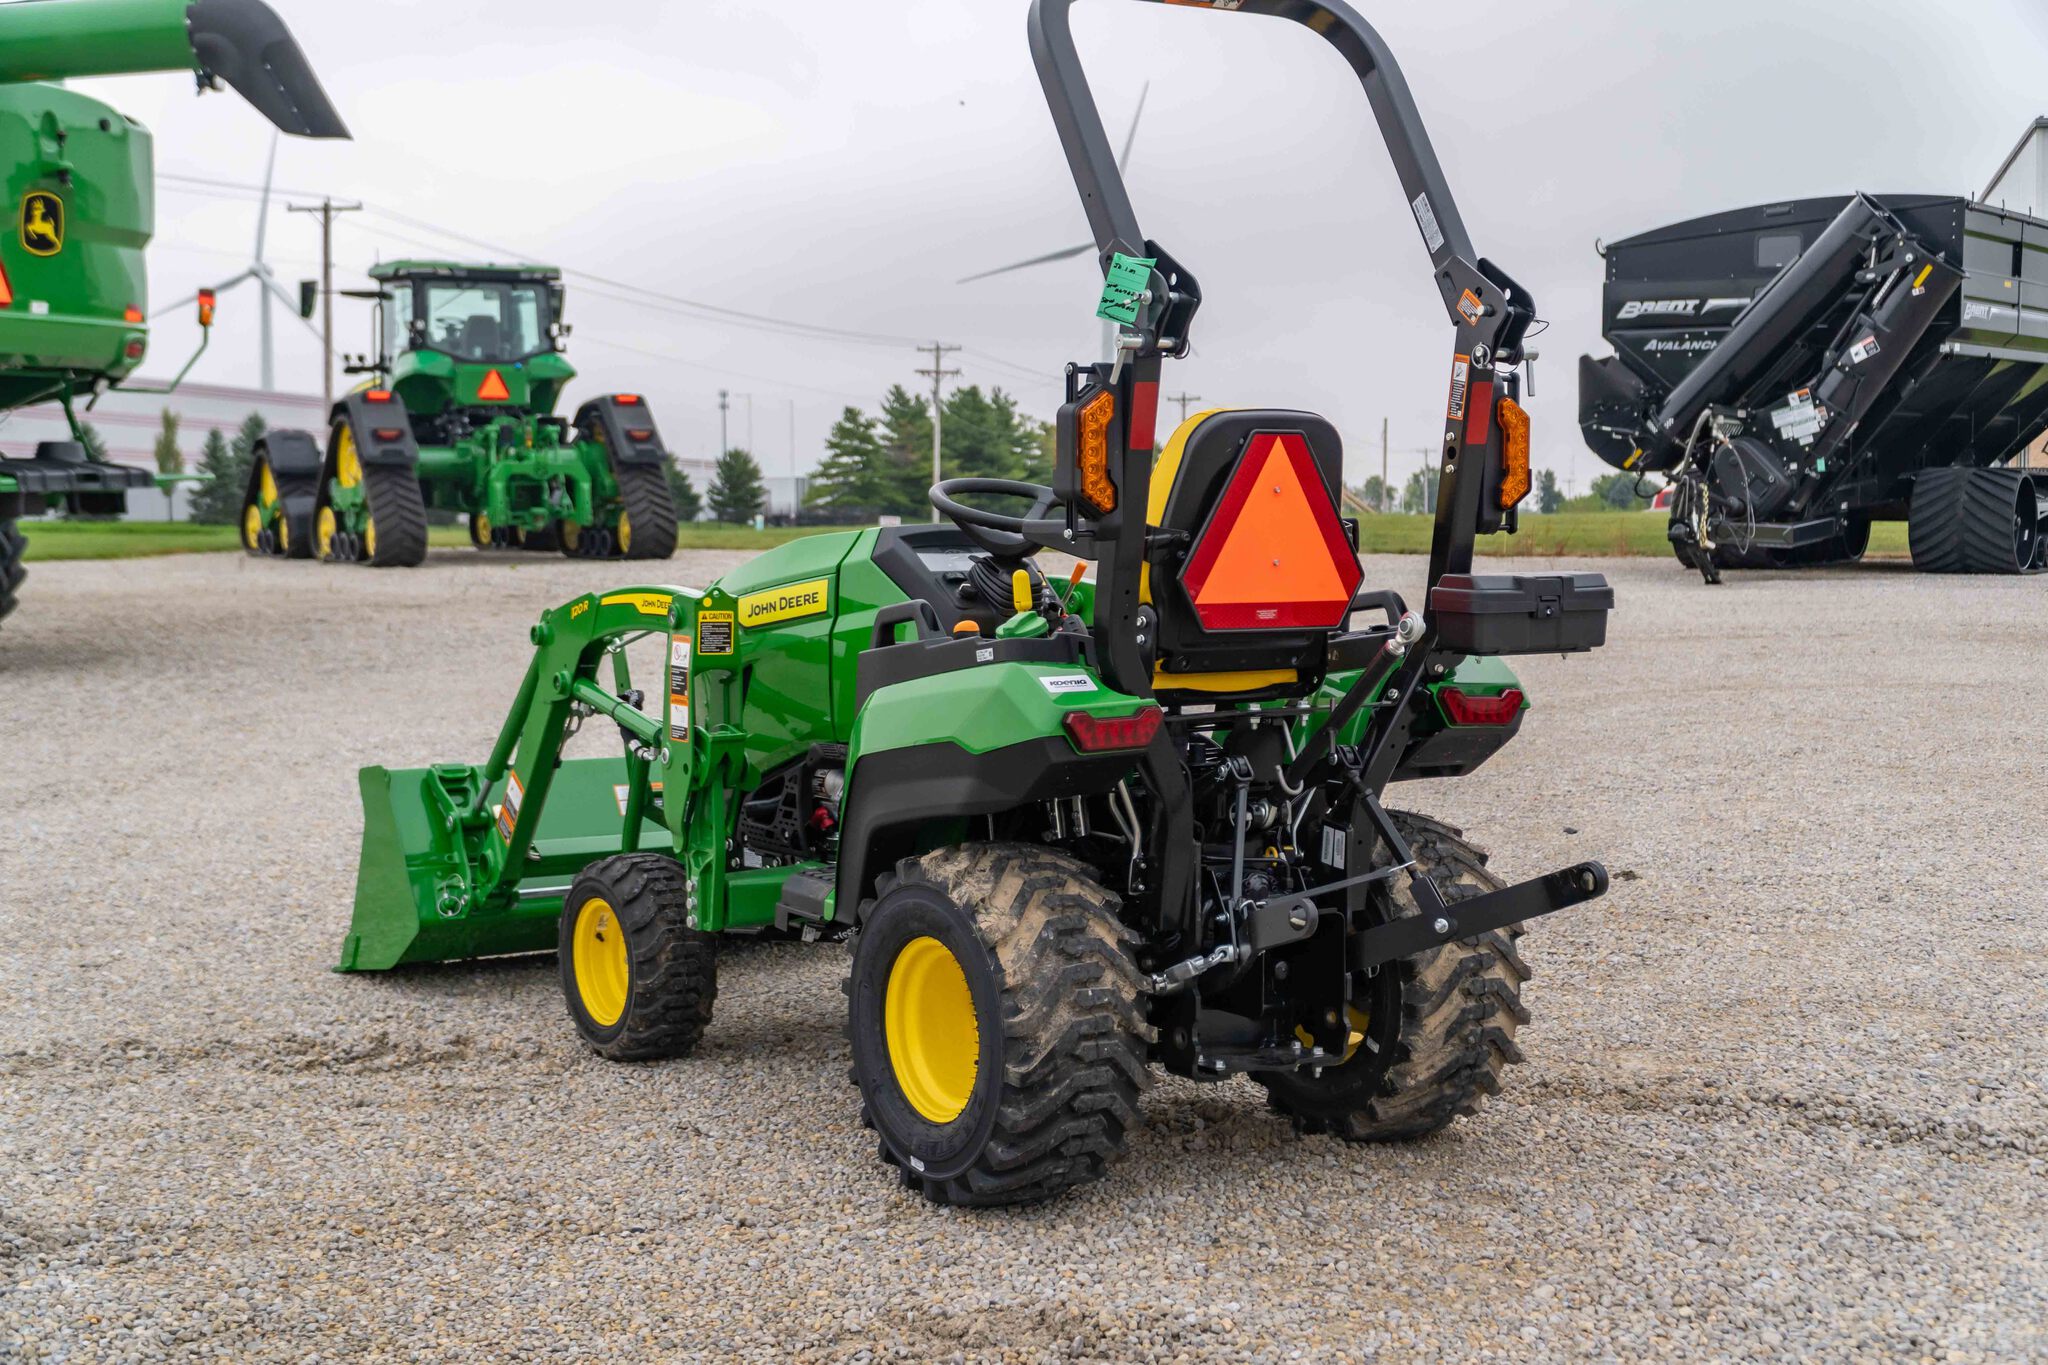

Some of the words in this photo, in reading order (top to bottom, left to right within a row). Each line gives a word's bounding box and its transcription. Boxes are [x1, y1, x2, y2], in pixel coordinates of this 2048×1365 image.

[641, 599, 656, 608] JOHN
[747, 601, 777, 618] JOHN
[779, 592, 819, 611] DEERE
[708, 612, 732, 620] CAUTION
